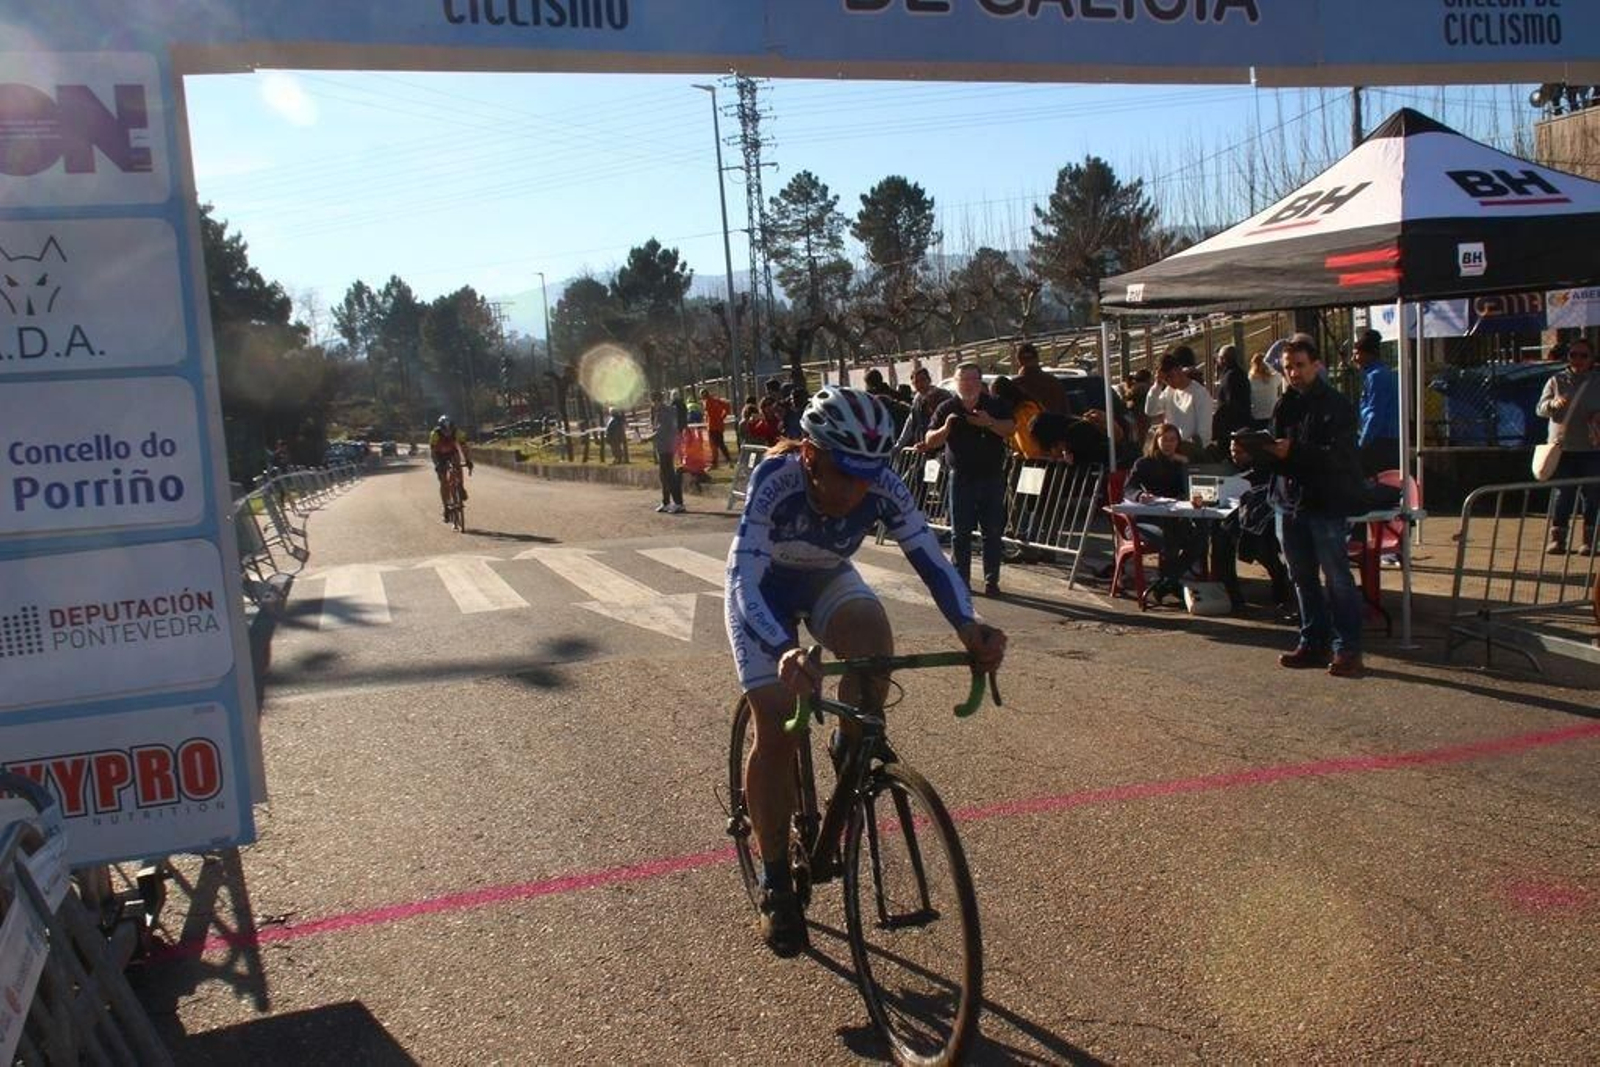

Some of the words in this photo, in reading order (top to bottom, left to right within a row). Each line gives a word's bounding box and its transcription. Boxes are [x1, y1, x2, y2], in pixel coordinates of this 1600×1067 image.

[1444, 12, 1562, 46] CICLISMO
[1445, 170, 1562, 198] BH
[1260, 181, 1373, 227] BH
[1462, 251, 1483, 264] BH
[0, 324, 105, 359] .D.A.
[8, 434, 131, 466] Concello
[141, 432, 177, 458] do
[13, 468, 185, 512] Porriño
[50, 588, 215, 629] DEPUTACIÓN
[52, 613, 221, 650] PONTEVEDRA
[0, 737, 223, 818] YPRO
